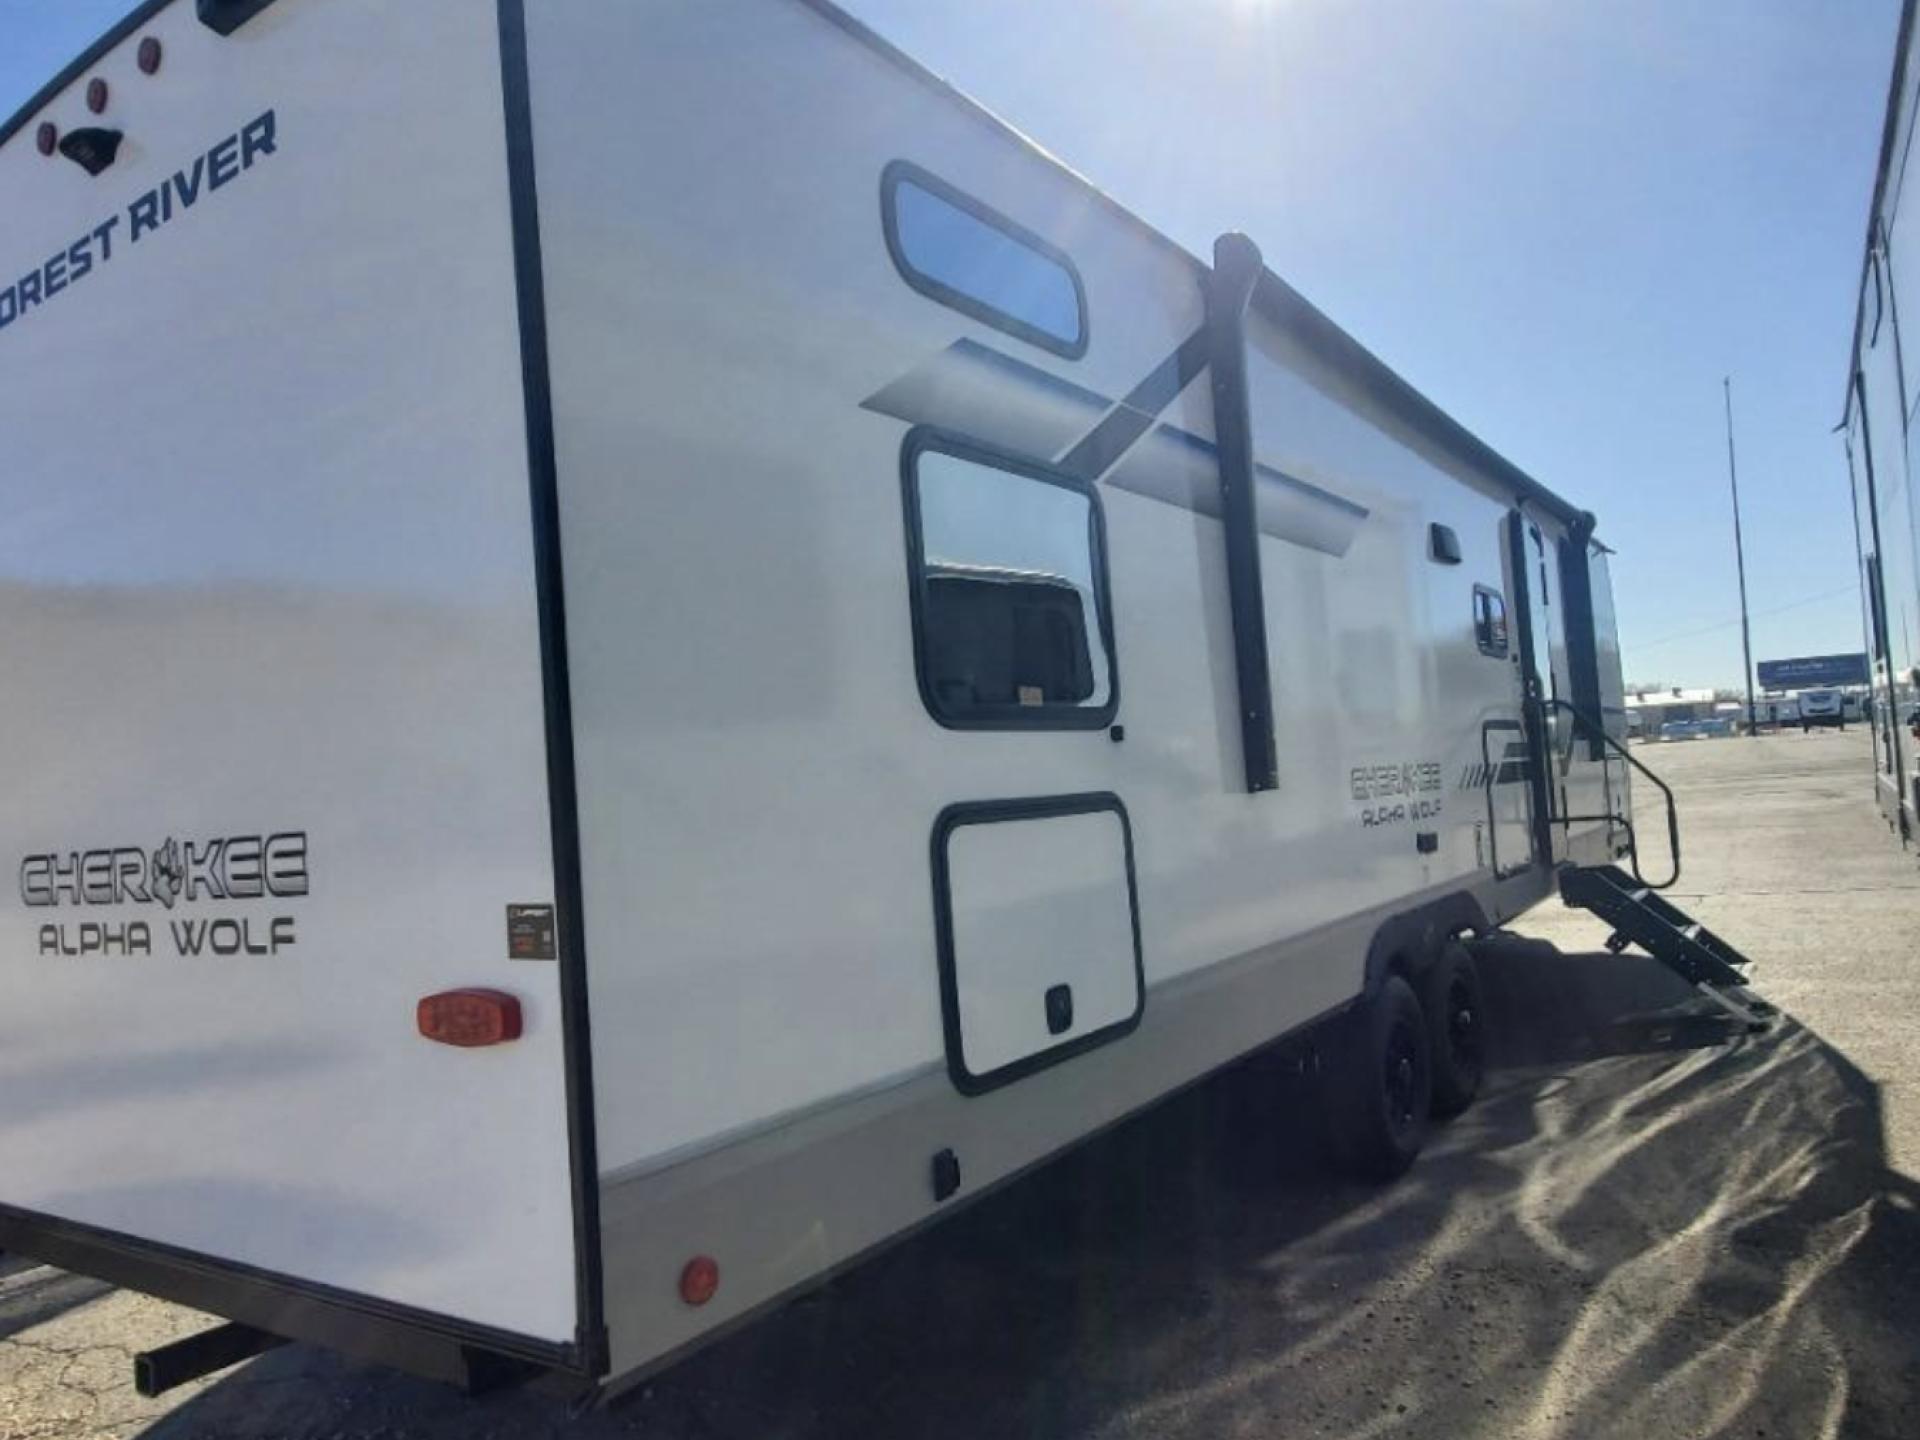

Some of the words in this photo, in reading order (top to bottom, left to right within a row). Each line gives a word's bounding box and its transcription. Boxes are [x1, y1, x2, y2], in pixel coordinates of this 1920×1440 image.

[128, 109, 277, 242] RIVER
[39, 921, 151, 956] ALPHA
[170, 916, 295, 956] WOLF
